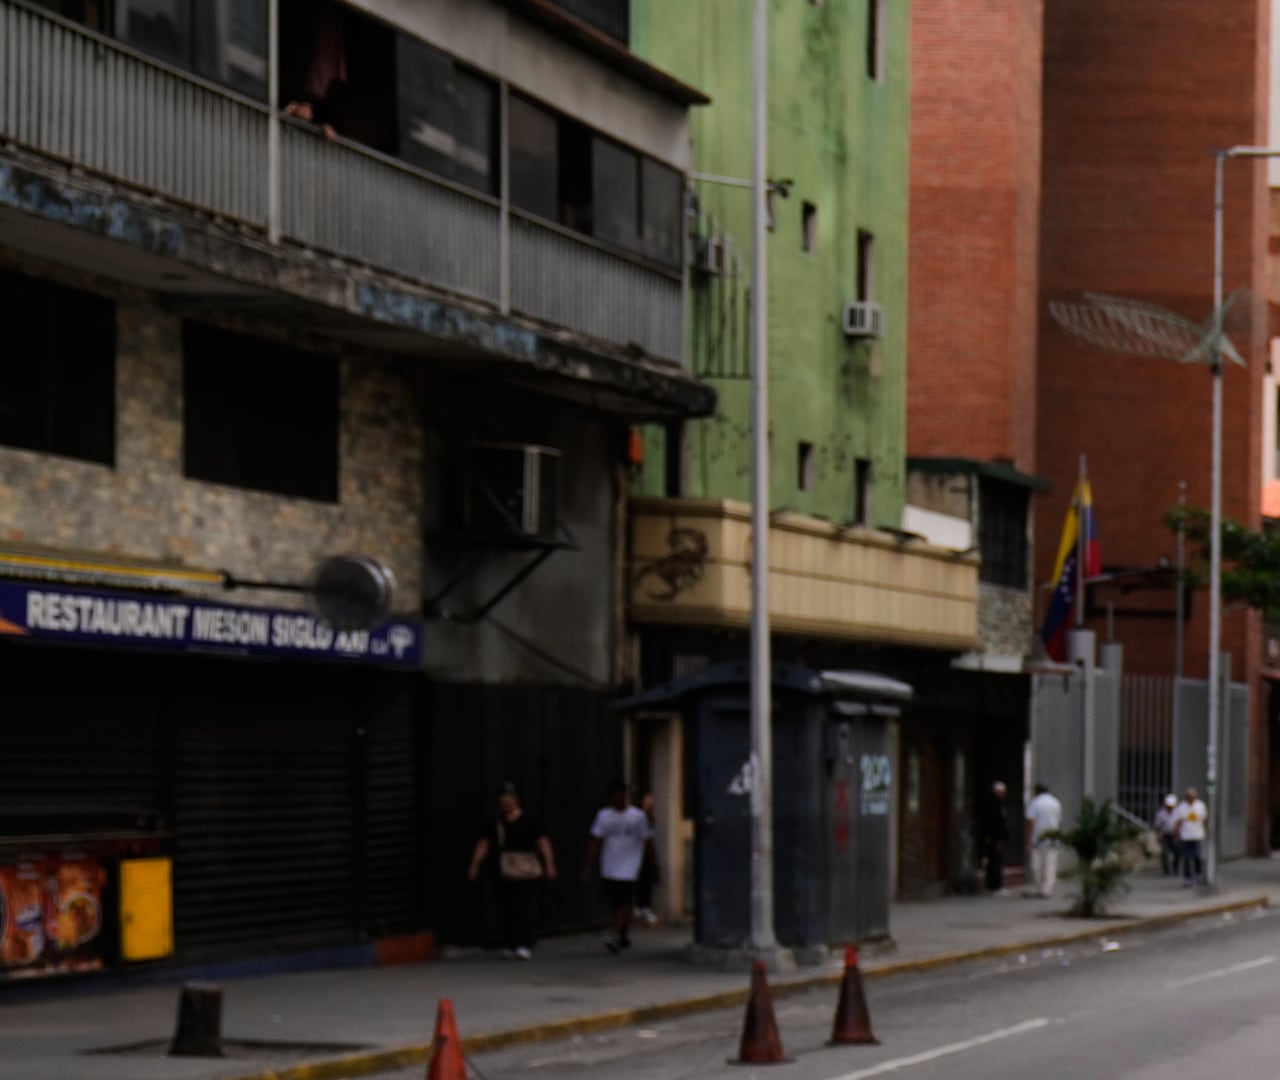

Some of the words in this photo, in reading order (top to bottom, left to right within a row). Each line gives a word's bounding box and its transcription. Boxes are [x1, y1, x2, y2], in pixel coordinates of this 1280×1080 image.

[27, 591, 188, 640] RESTAURANT
[192, 607, 269, 645] MESON
[271, 614, 333, 651] SIGLO
